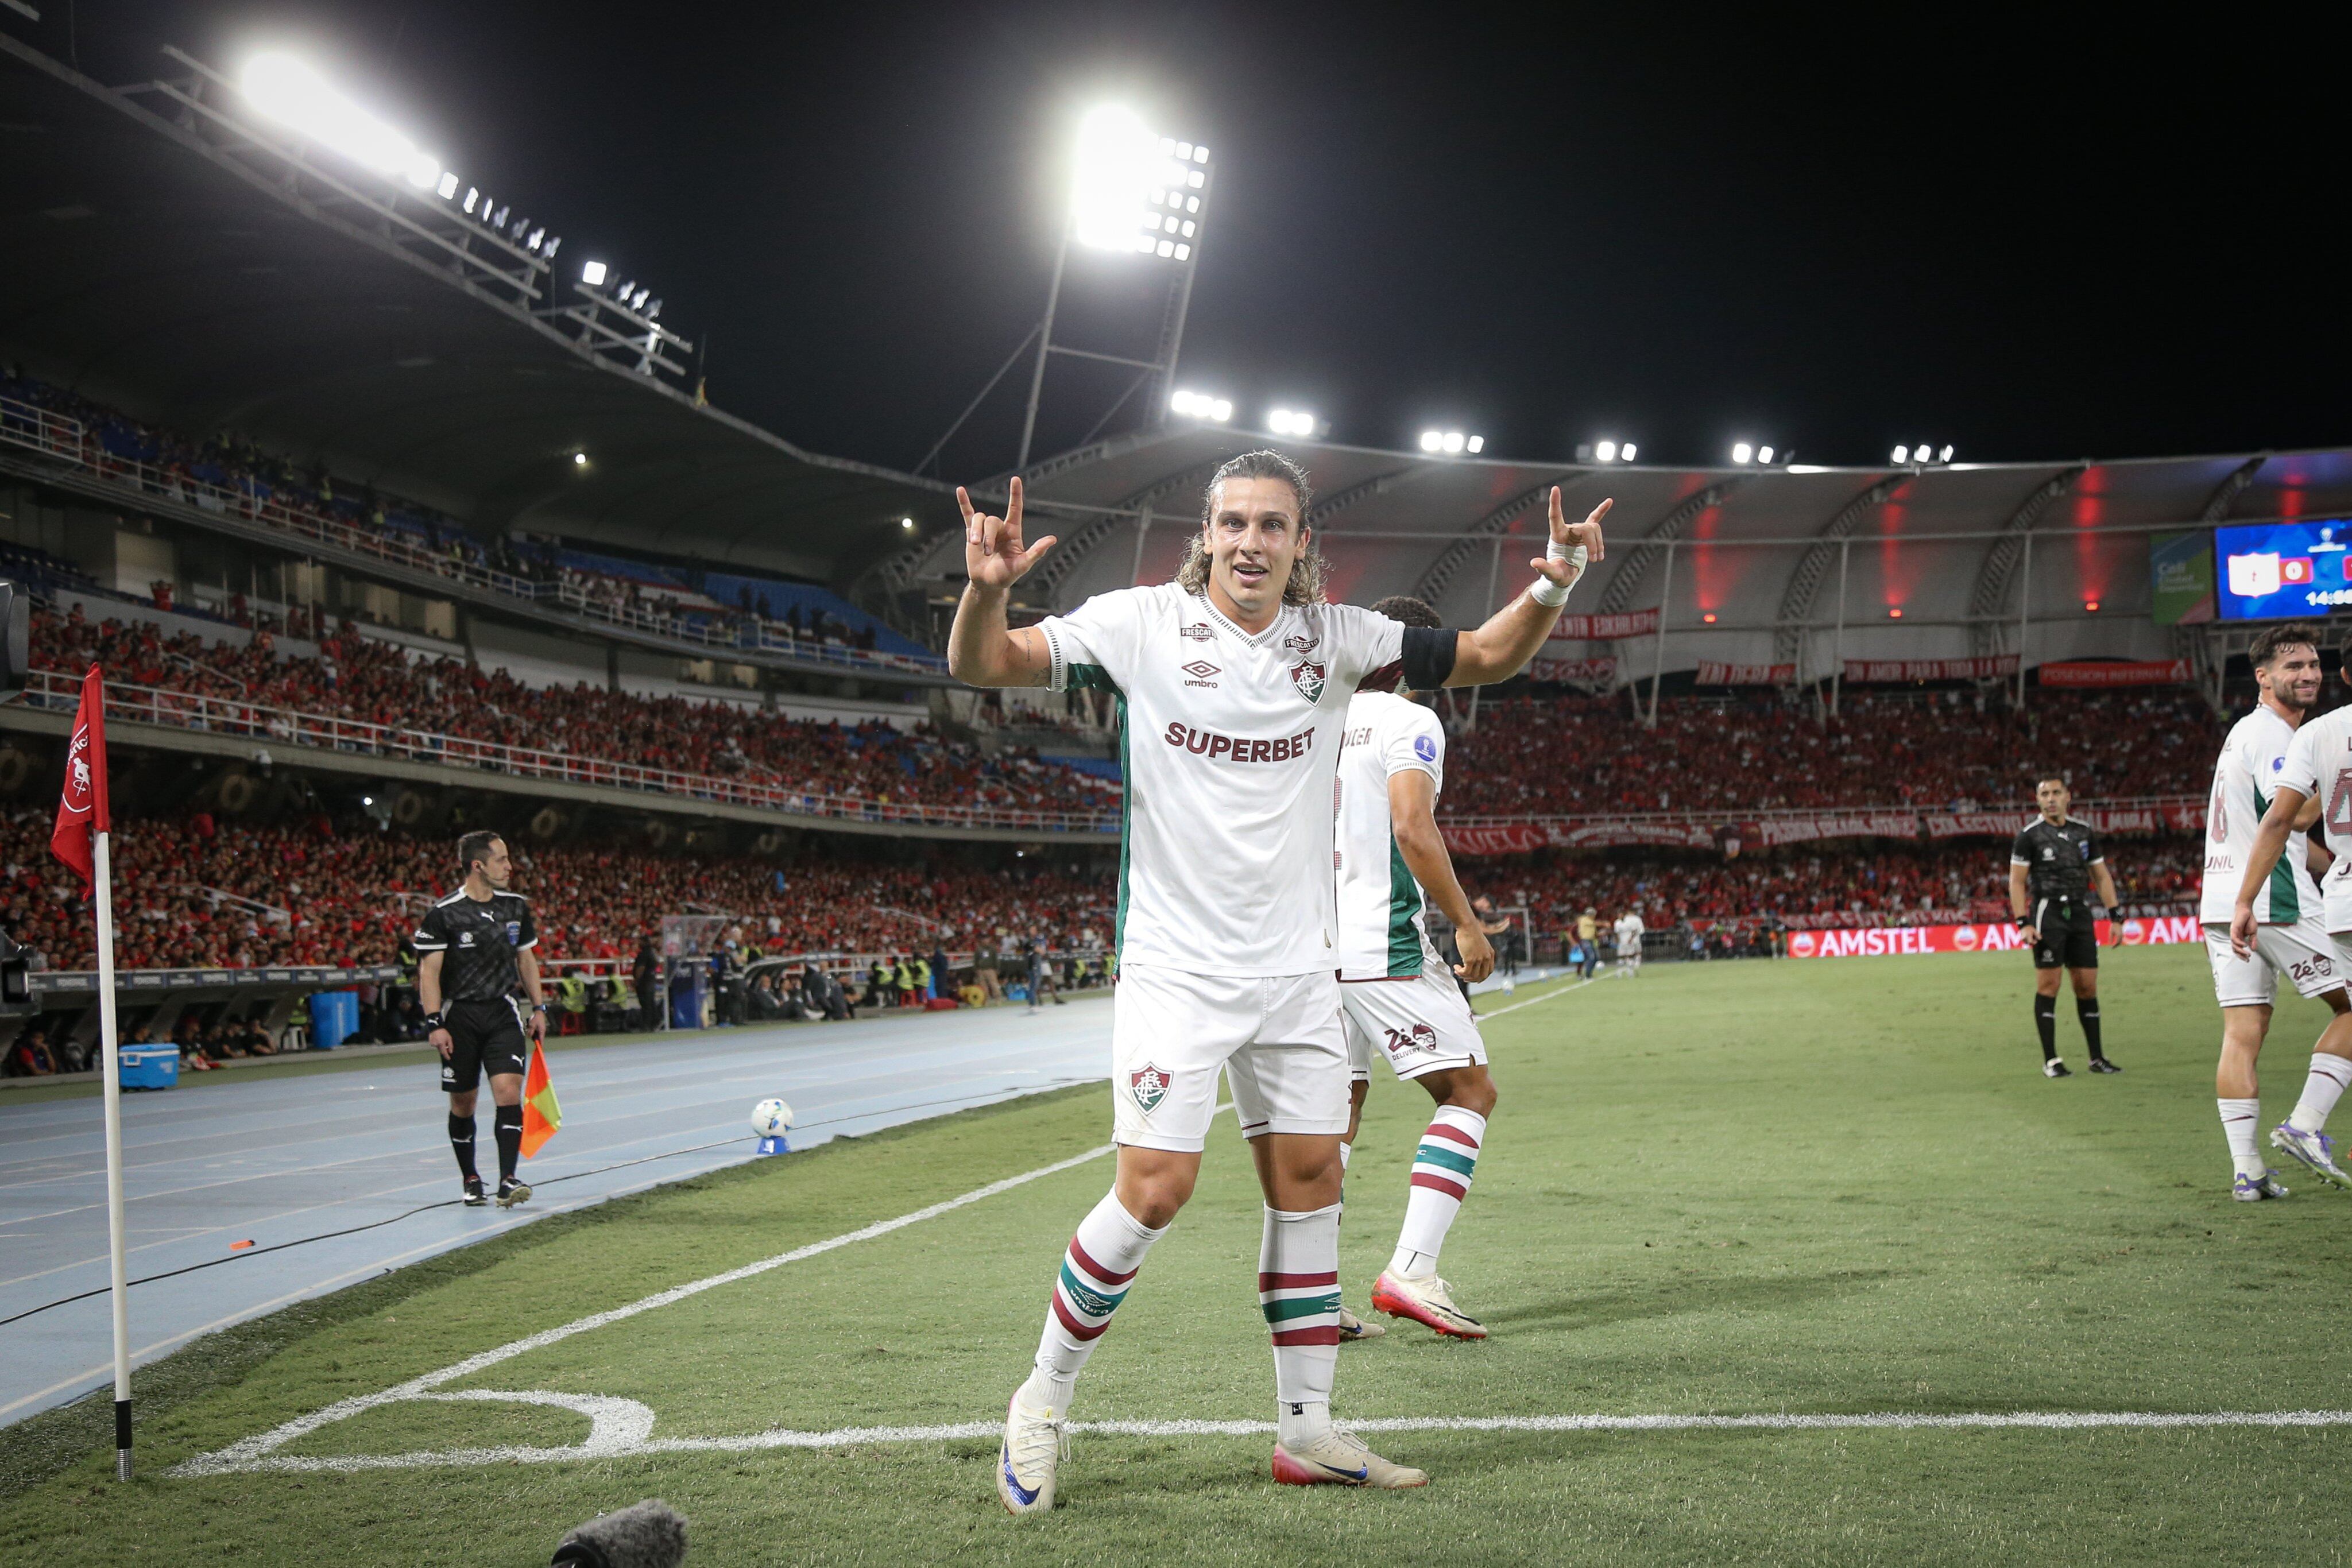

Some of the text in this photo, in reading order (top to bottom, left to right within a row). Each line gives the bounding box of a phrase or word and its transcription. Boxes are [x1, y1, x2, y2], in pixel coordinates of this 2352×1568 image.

[1286, 638, 1318, 649] FRESCATTO
[1184, 679, 1218, 689] umbro
[1165, 722, 1315, 762] SUPERBET
[1819, 927, 1935, 957] AMSTEL
[2290, 960, 2315, 981] Zé
[1384, 1028, 1417, 1052] Zé
[1392, 1047, 1421, 1060] DELIVERY
[1070, 1289, 1109, 1314] umbro
